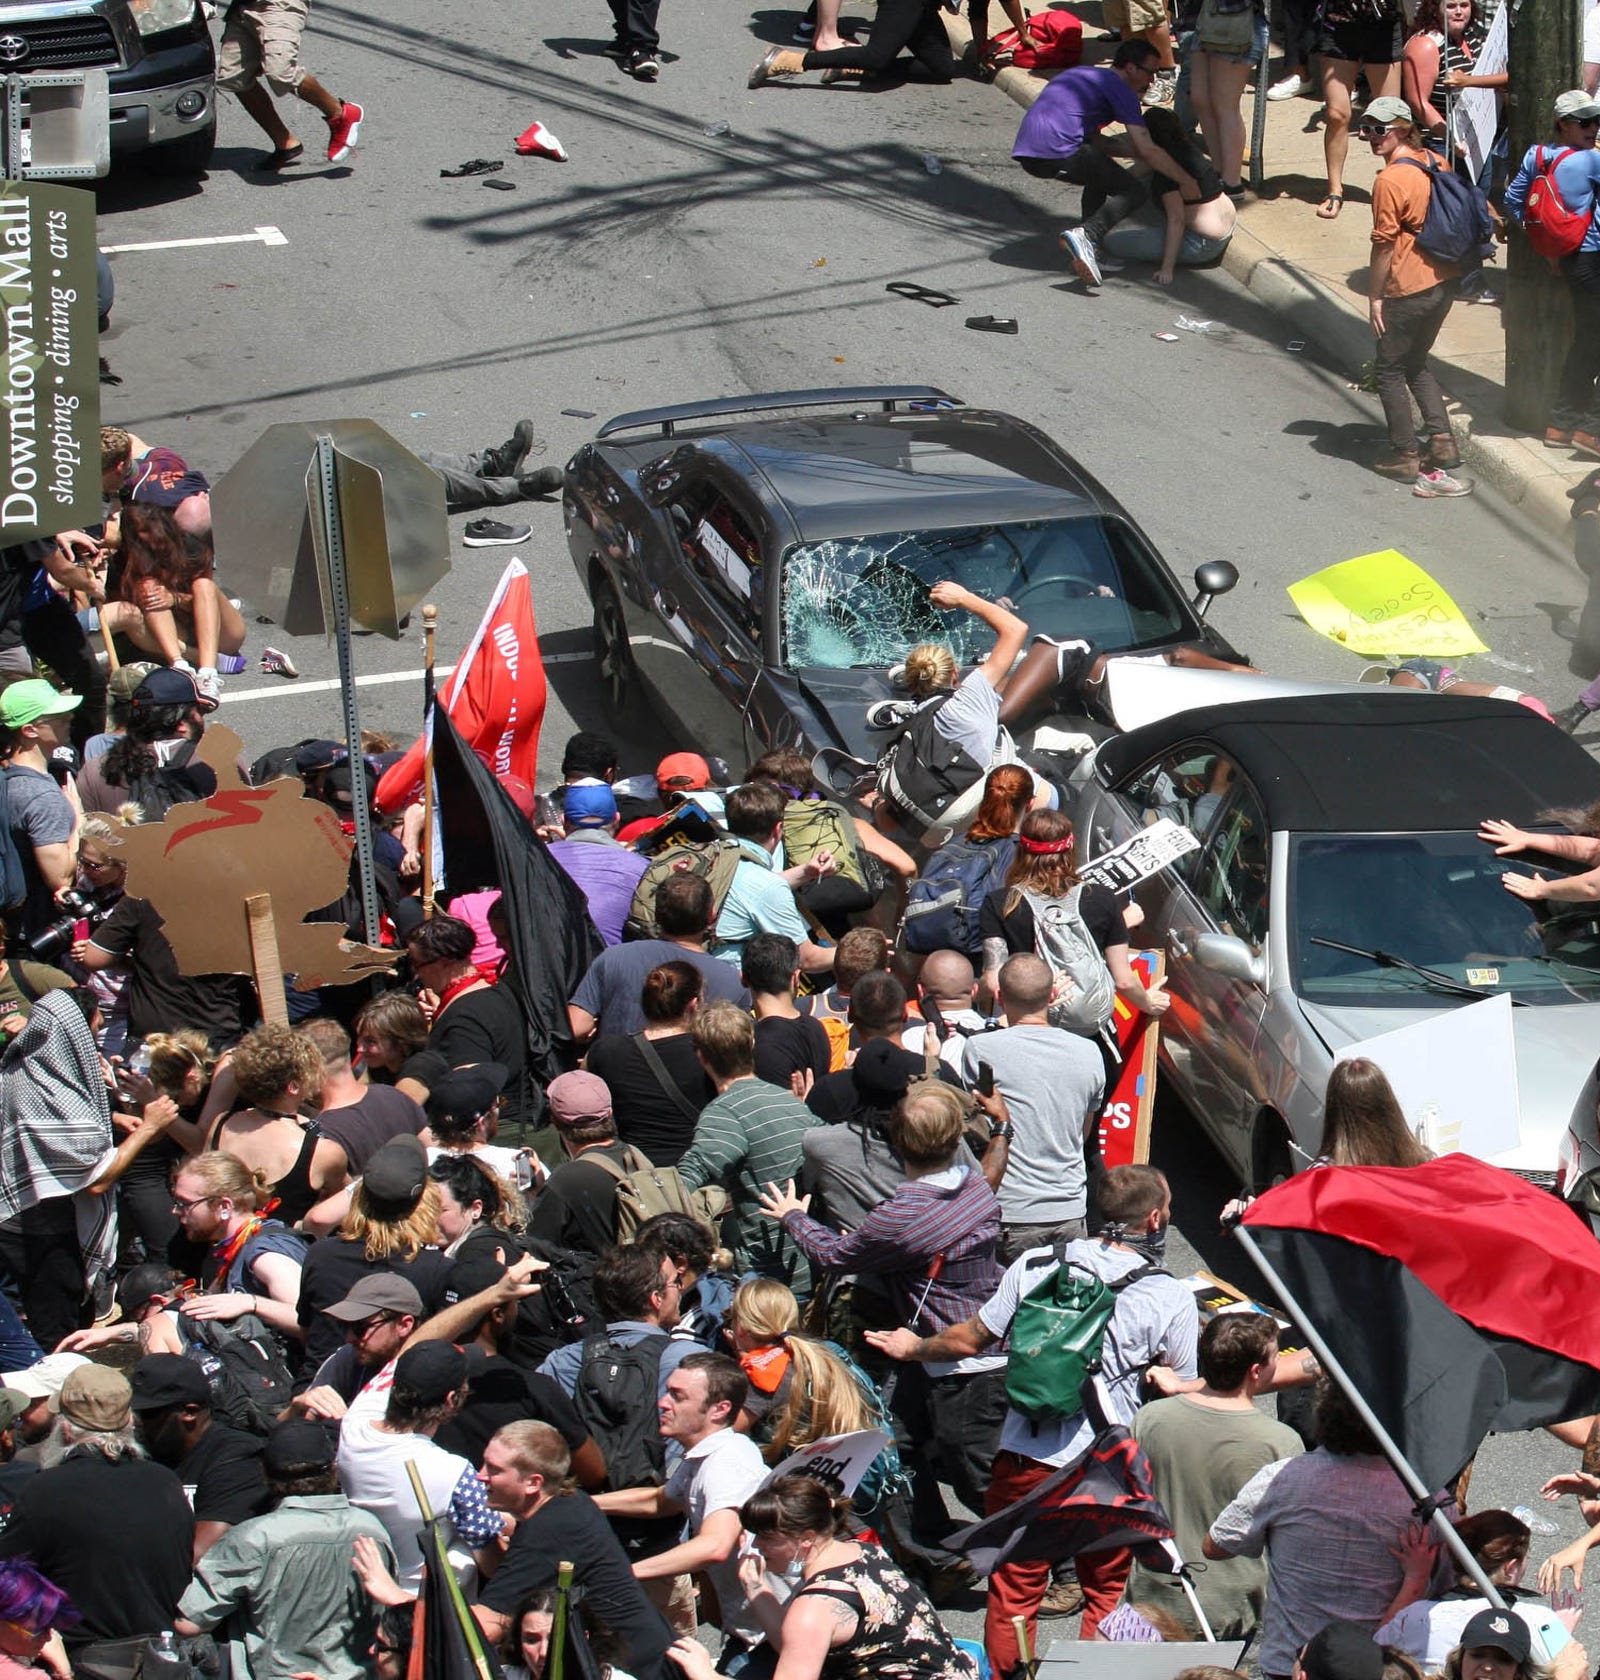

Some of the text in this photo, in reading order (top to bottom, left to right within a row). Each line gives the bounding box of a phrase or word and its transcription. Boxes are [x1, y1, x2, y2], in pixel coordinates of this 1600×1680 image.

[0, 194, 39, 529] Downtown Mall
[44, 209, 81, 505] shopping dining arts
[805, 1455, 853, 1479] end
